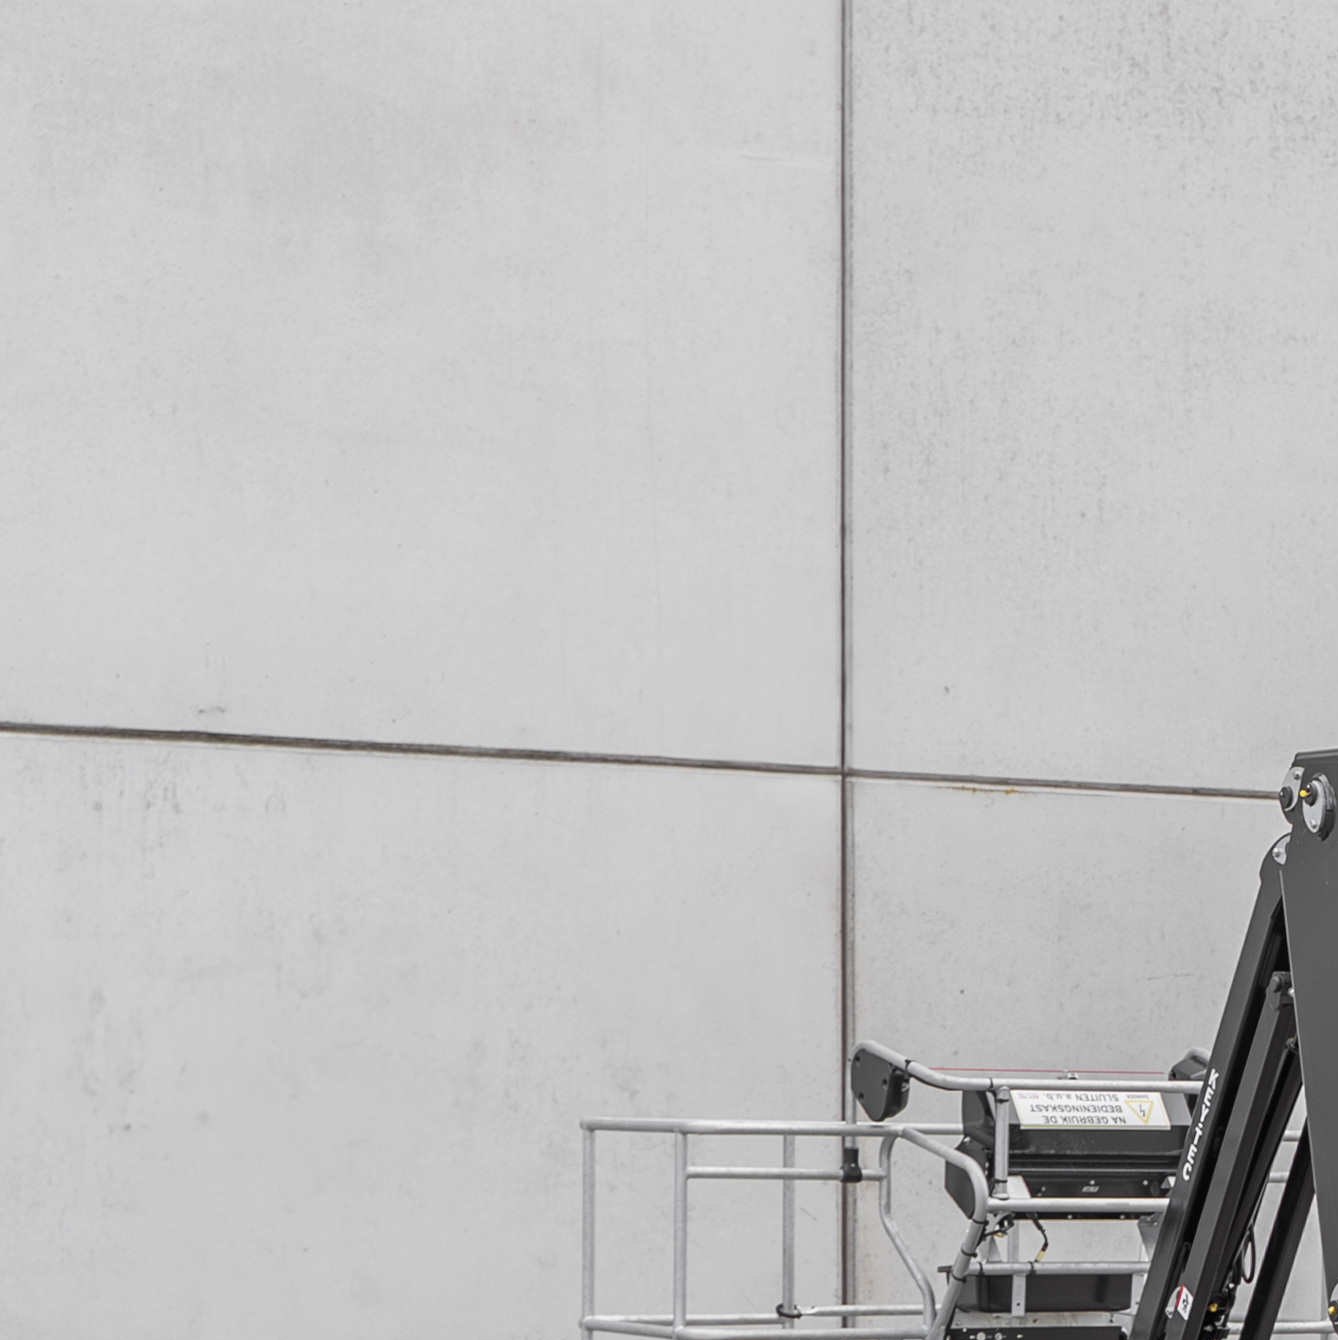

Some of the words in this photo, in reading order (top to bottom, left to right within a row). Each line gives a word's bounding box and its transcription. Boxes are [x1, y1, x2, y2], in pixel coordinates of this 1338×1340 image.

[1075, 1093, 1119, 1102] SLUITEN
[1029, 1104, 1123, 1113] BEDIENINGSKAST
[1042, 1115, 1058, 1124] DE
[1060, 1115, 1108, 1124] GEBRUIK
[1111, 1115, 1127, 1124] NA
